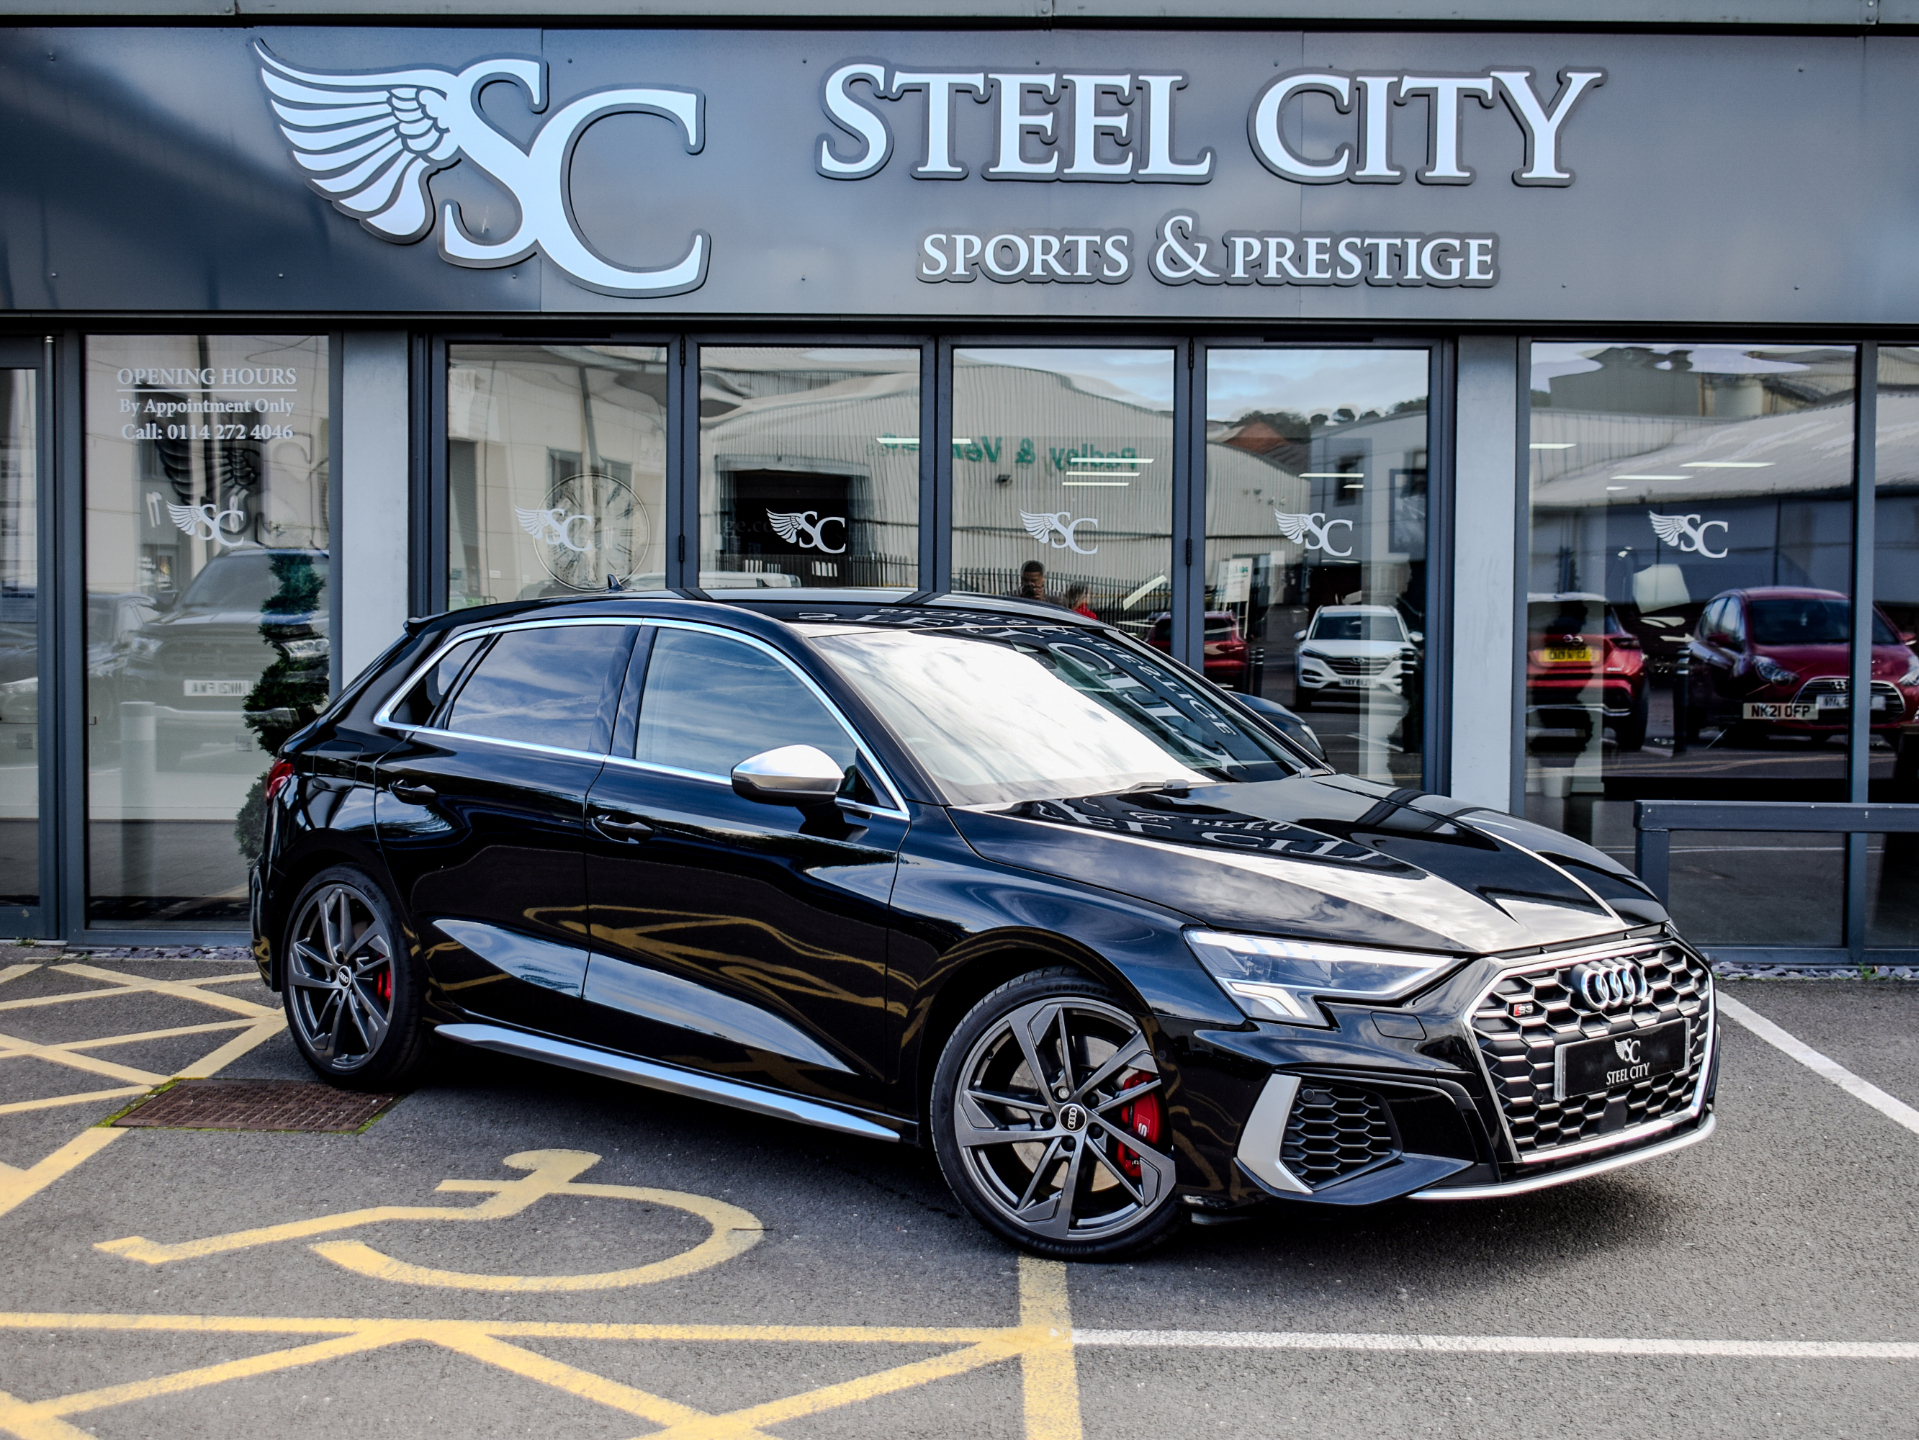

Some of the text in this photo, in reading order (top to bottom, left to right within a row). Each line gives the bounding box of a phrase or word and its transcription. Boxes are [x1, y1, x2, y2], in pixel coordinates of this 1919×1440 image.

[820, 62, 1604, 180] STEEL CITY
[443, 58, 704, 291] SC
[920, 214, 1495, 281] SPORTS & PRESTIGE
[117, 367, 298, 386] OPENING HOURS
[119, 397, 295, 418] By Appointment Only
[121, 423, 294, 440] Call: 0114 272 4046
[198, 502, 245, 547] SC
[545, 507, 593, 553] SC
[798, 510, 847, 555] SC
[1050, 510, 1100, 556] SC
[1305, 511, 1354, 558] SC
[1679, 512, 1730, 559] SC
[1750, 703, 1782, 719] NK21
[1517, 1005, 1534, 1015] S3
[1605, 1061, 1650, 1086] STEEL CITY
